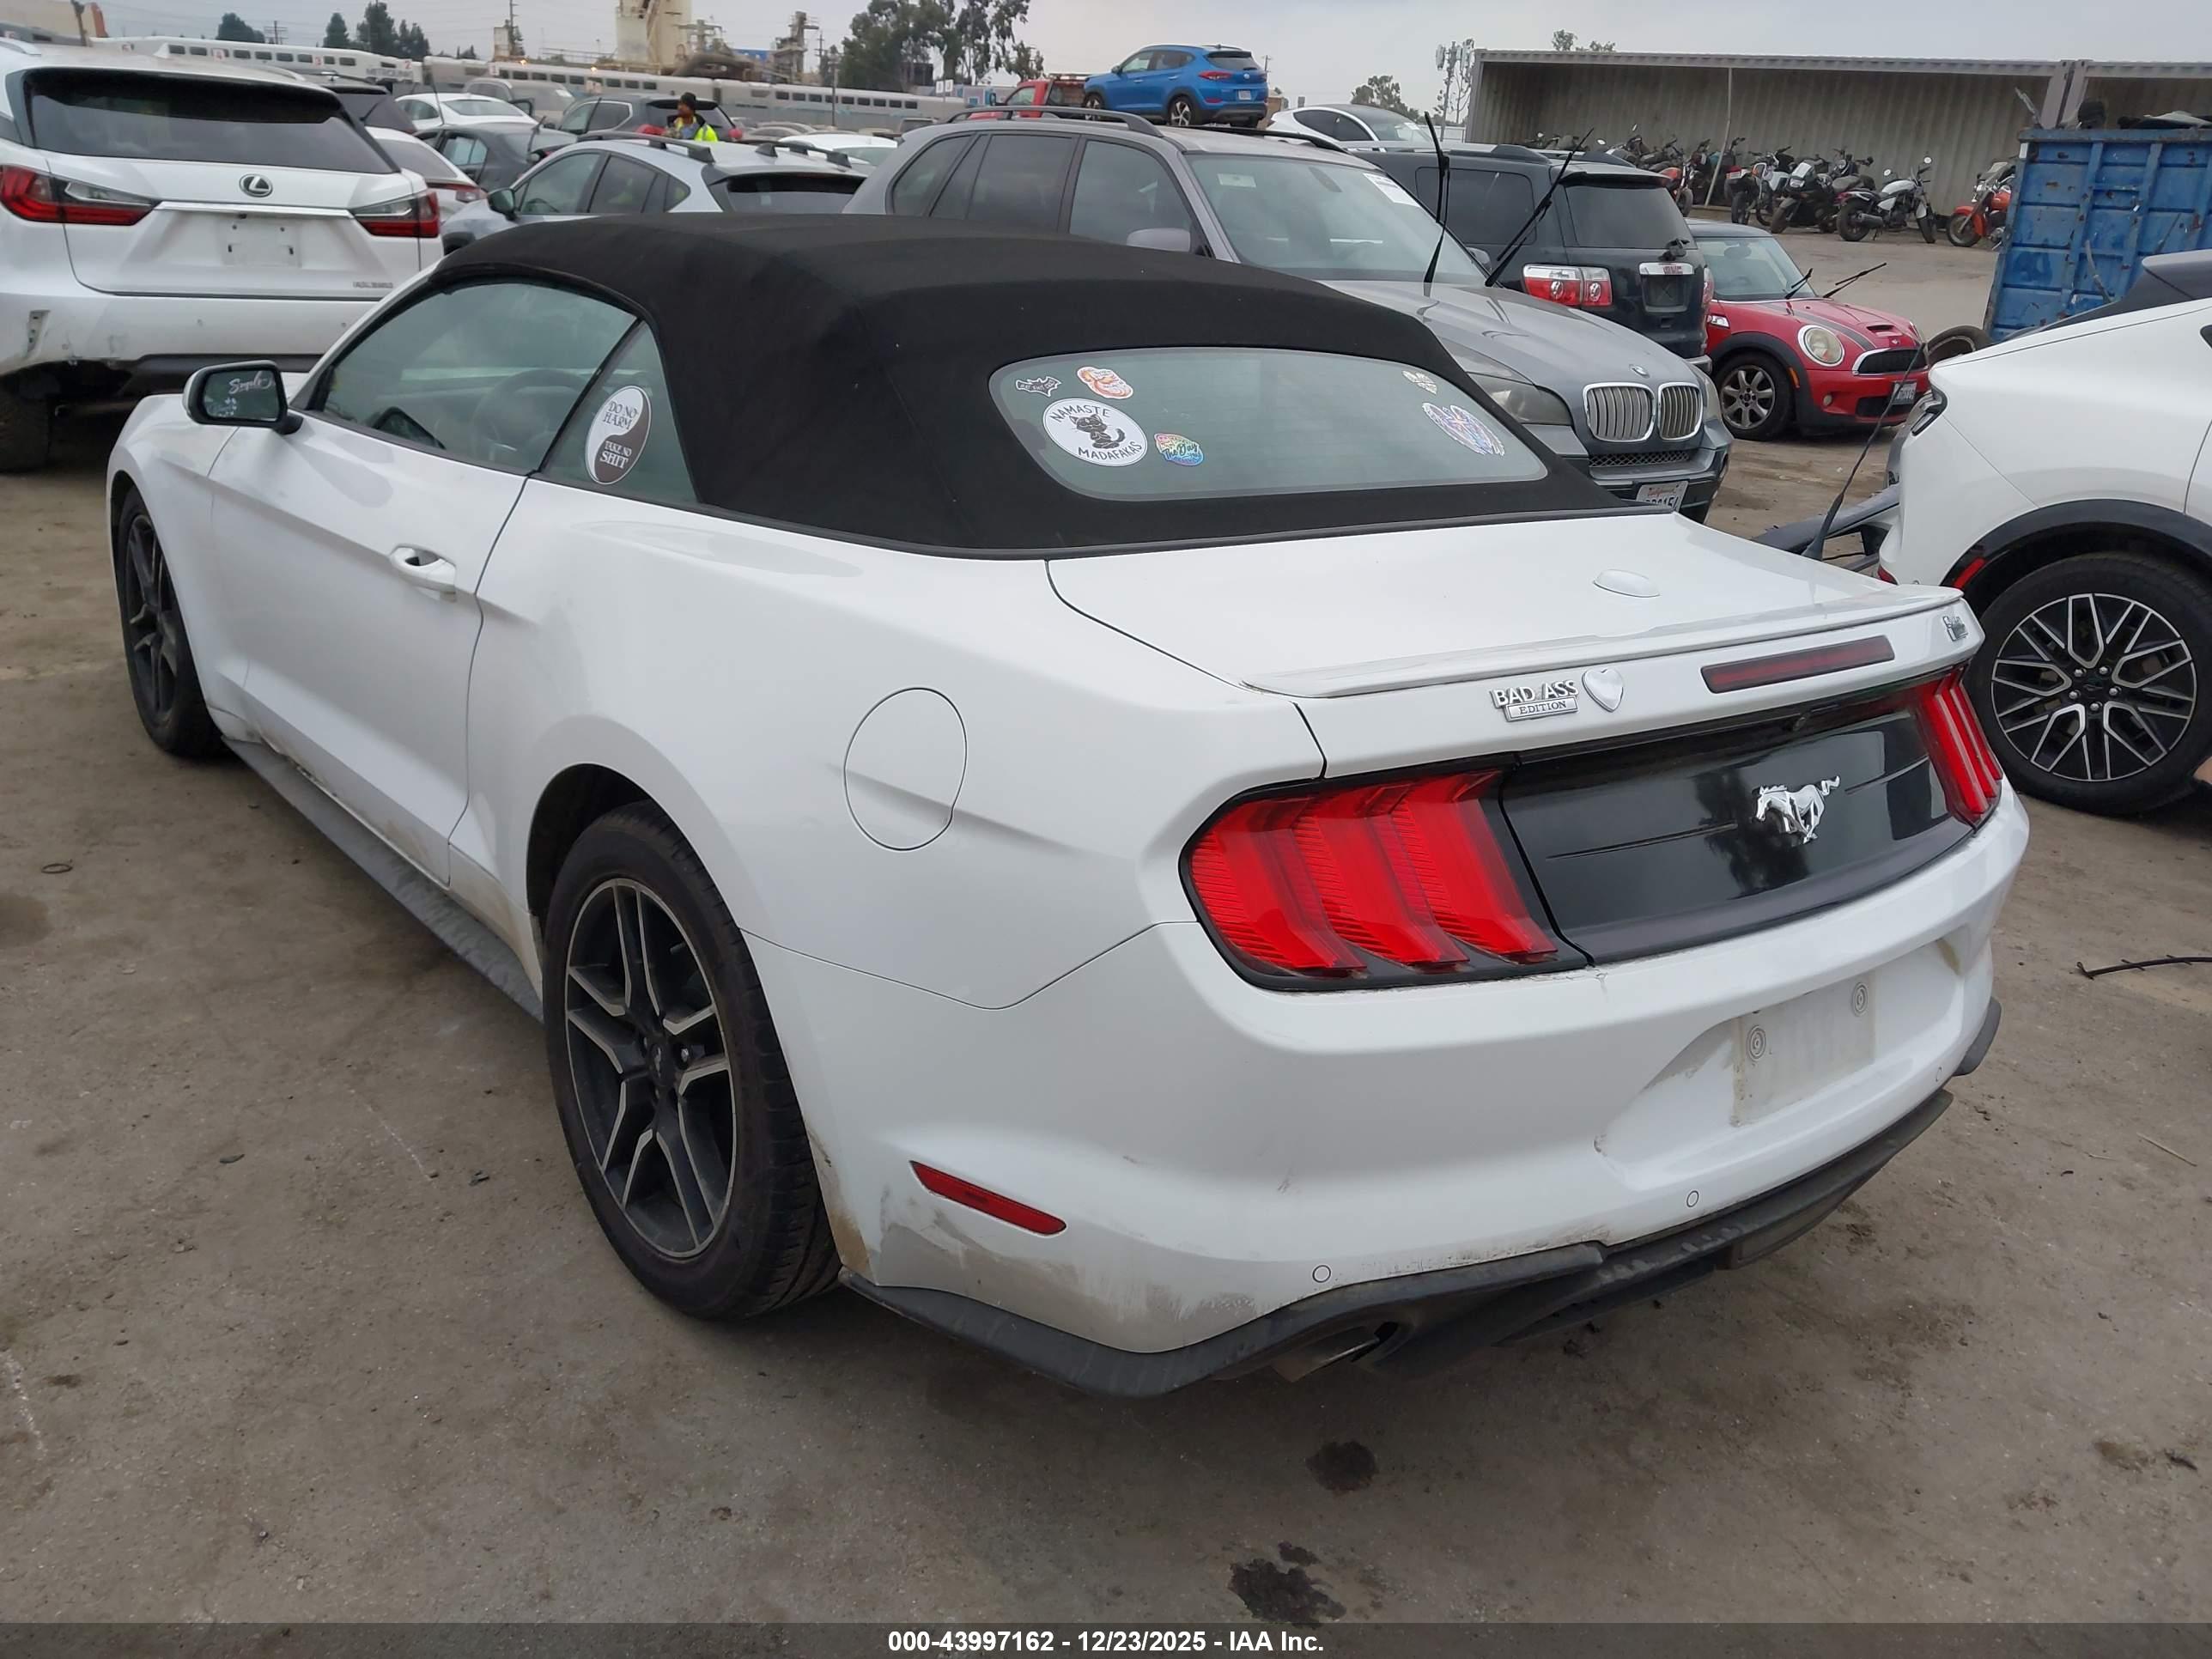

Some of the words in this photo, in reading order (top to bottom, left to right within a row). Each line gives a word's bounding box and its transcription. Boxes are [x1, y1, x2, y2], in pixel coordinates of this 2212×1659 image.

[404, 59, 412, 70] 2
[609, 401, 623, 414] DO
[624, 404, 638, 419] NO
[1049, 404, 1111, 422] NAMASTE
[603, 412, 632, 430] HARM
[600, 450, 629, 469] SHIT
[1078, 441, 1143, 461] MADAFAKAS
[1489, 685, 1535, 708] BAD
[1541, 679, 1579, 700] ASS
[1518, 700, 1567, 715] EDITION
